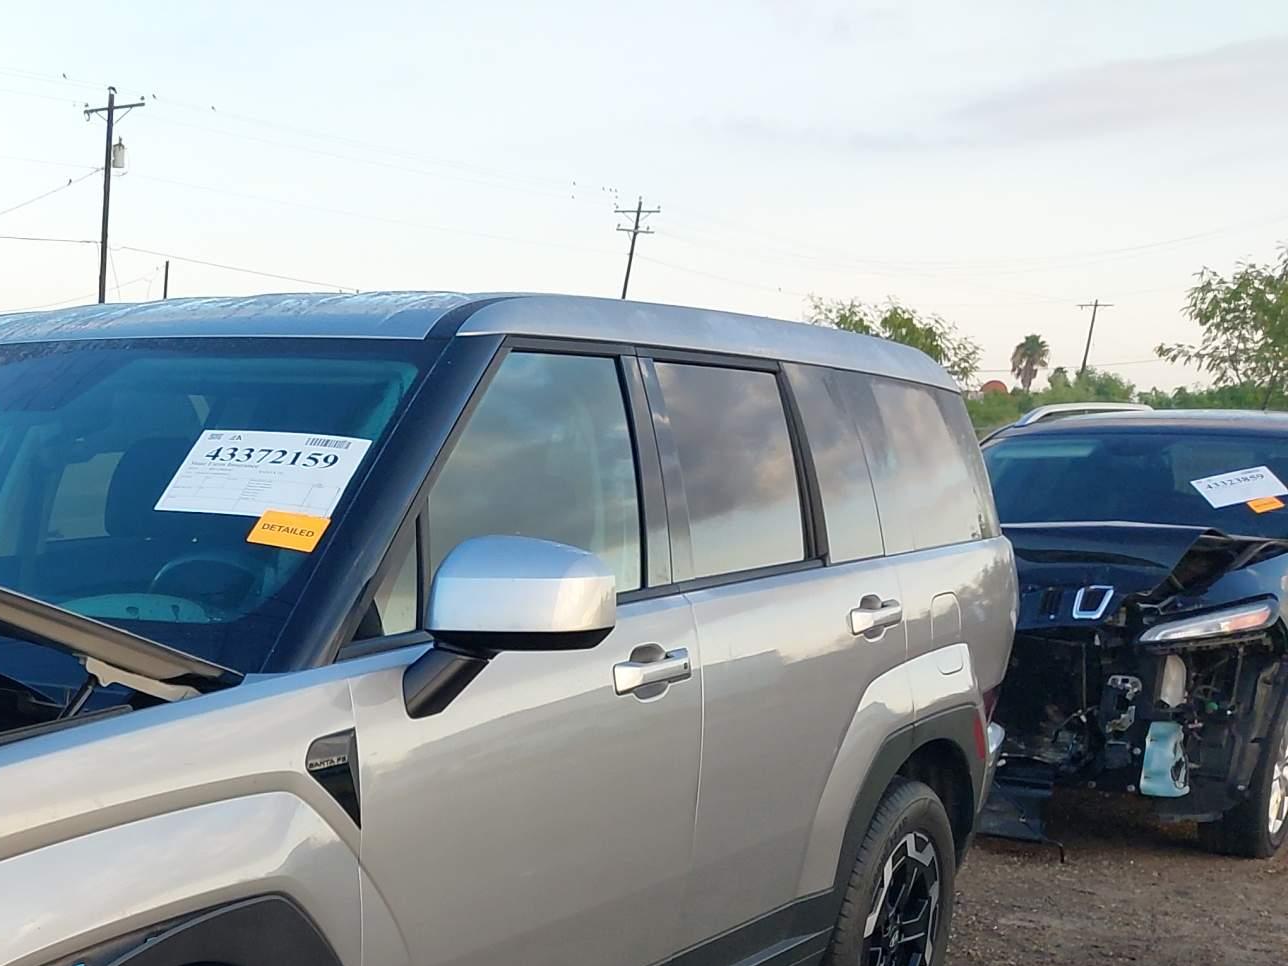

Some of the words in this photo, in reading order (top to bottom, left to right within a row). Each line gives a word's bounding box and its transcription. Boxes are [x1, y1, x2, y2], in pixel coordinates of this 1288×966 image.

[205, 446, 339, 469] 43372159
[261, 522, 315, 538] DETAILED
[309, 759, 336, 769] SANTA
